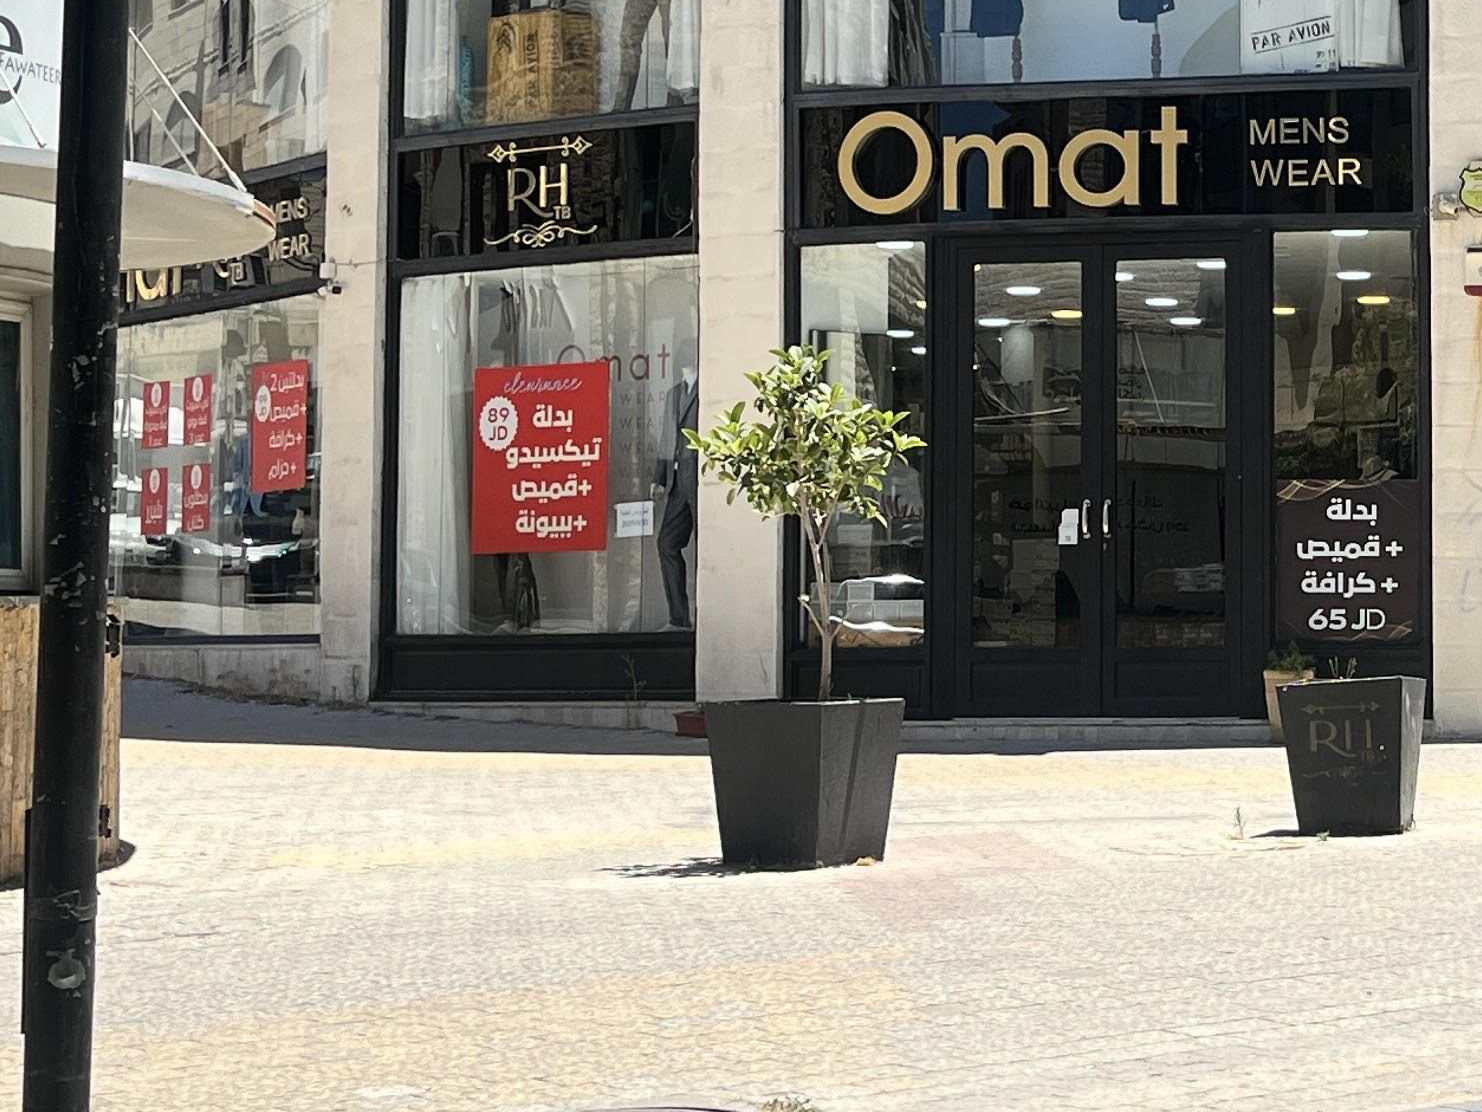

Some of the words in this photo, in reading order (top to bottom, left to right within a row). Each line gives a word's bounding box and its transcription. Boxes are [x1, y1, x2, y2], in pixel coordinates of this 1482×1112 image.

[1251, 32, 1282, 51] PAR
[1288, 20, 1331, 43] AVION
[1248, 116, 1350, 146] MENS
[838, 105, 1188, 216] Omat
[1250, 157, 1362, 188] WEAR
[506, 162, 570, 218] RH
[272, 196, 309, 224] ENS
[268, 233, 312, 262] WEAR
[487, 407, 510, 423] 89
[532, 403, 574, 432] بدلة
[489, 426, 508, 441] JD
[505, 437, 602, 469] تيكسيدو
[1326, 496, 1378, 526] بدلة
[1308, 608, 1347, 630] 65
[1351, 608, 1386, 630] JD
